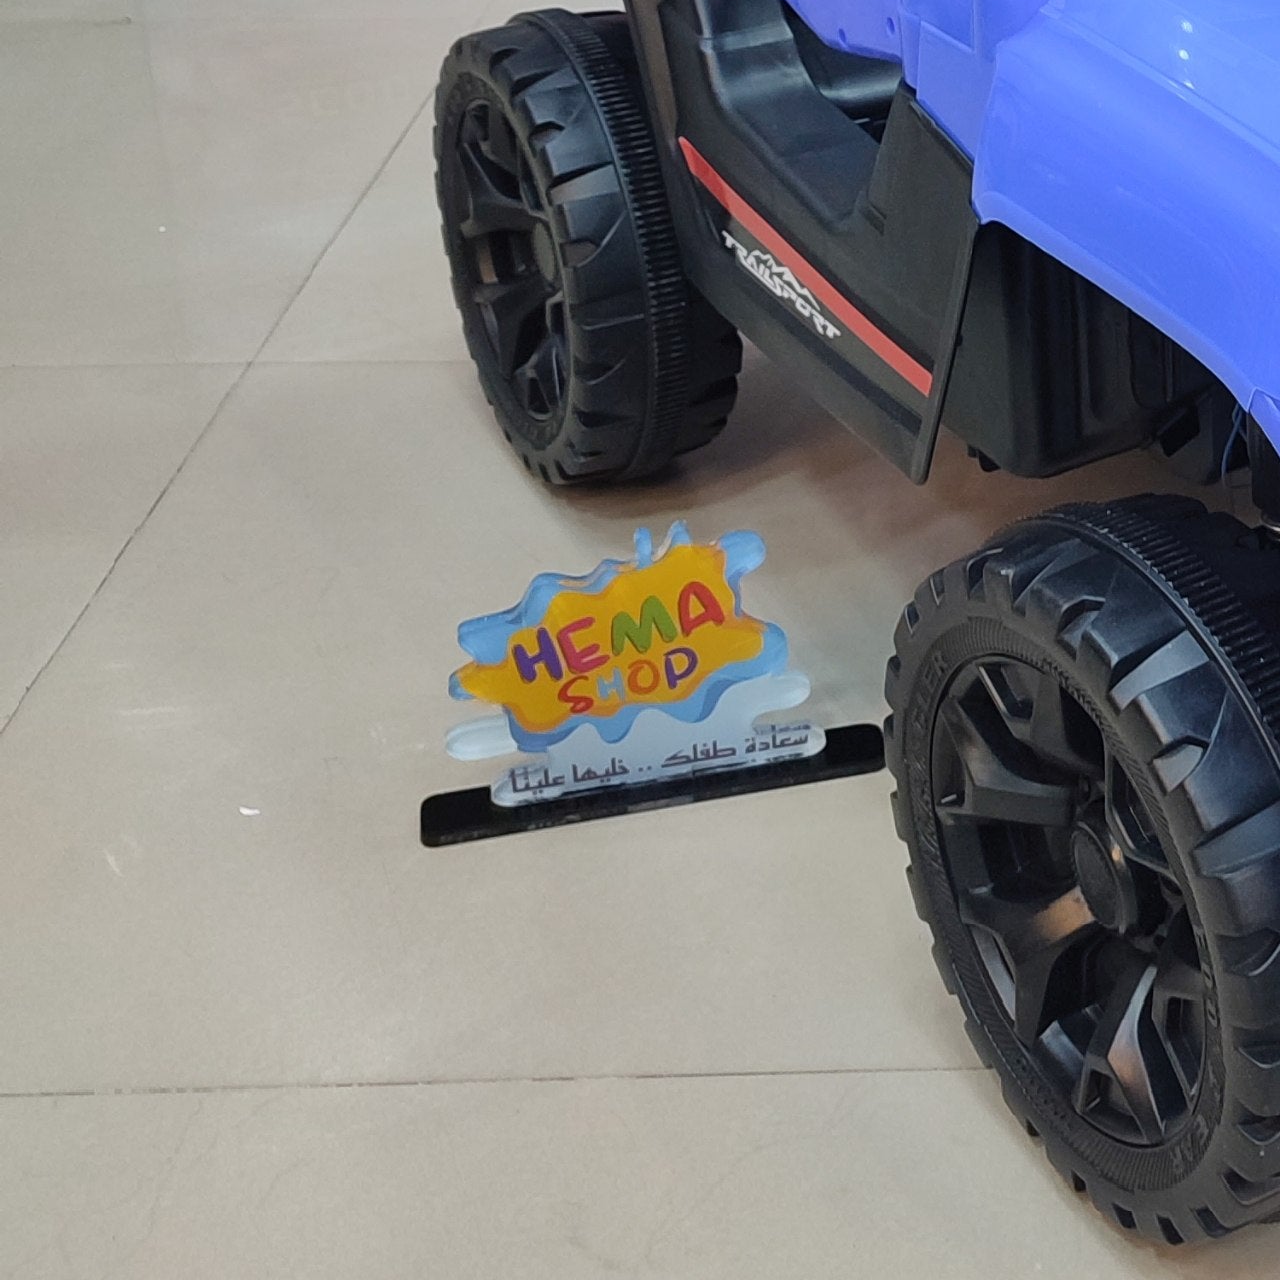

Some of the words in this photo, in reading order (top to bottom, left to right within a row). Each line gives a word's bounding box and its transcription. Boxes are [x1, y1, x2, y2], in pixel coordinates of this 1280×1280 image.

[511, 581, 725, 684] HEMA
[557, 647, 699, 714] SHOP
[661, 744, 737, 769] طفلك
[745, 733, 810, 754] سعادة
[572, 757, 631, 784] خليها
